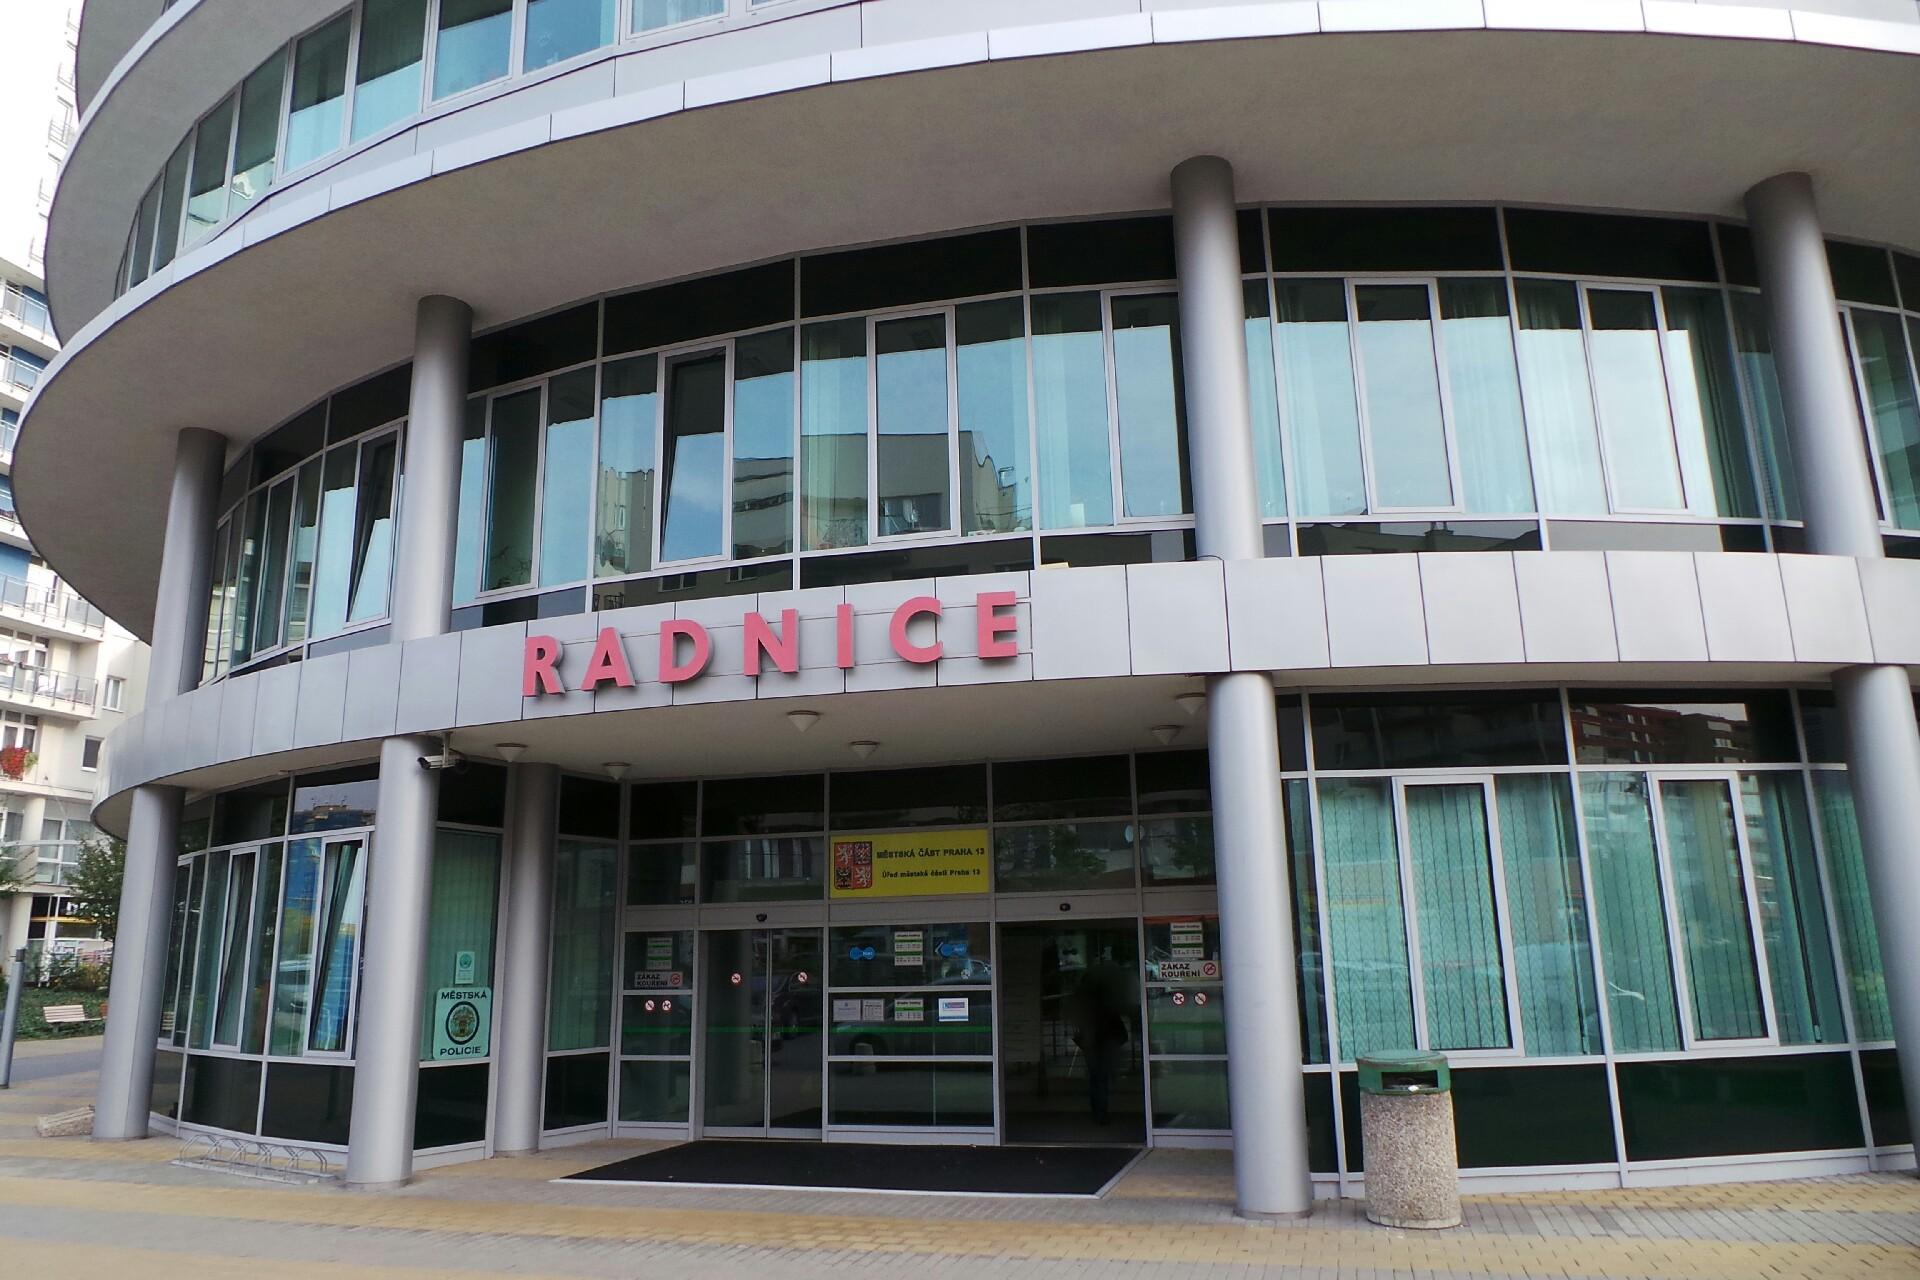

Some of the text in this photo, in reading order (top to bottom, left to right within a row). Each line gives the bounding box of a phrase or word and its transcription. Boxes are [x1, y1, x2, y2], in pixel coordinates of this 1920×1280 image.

[522, 590, 1019, 697] RADNICE
[876, 847, 985, 859] MĚSTSKÁ ČÁST PRAHA 13
[950, 868, 970, 876] Praha
[1161, 962, 1190, 970] ZÁKAZ
[1161, 969, 1200, 978] KOUŘENÍ
[441, 989, 487, 1000] MĚSTSKÁ
[440, 1046, 481, 1056] POLICIE
